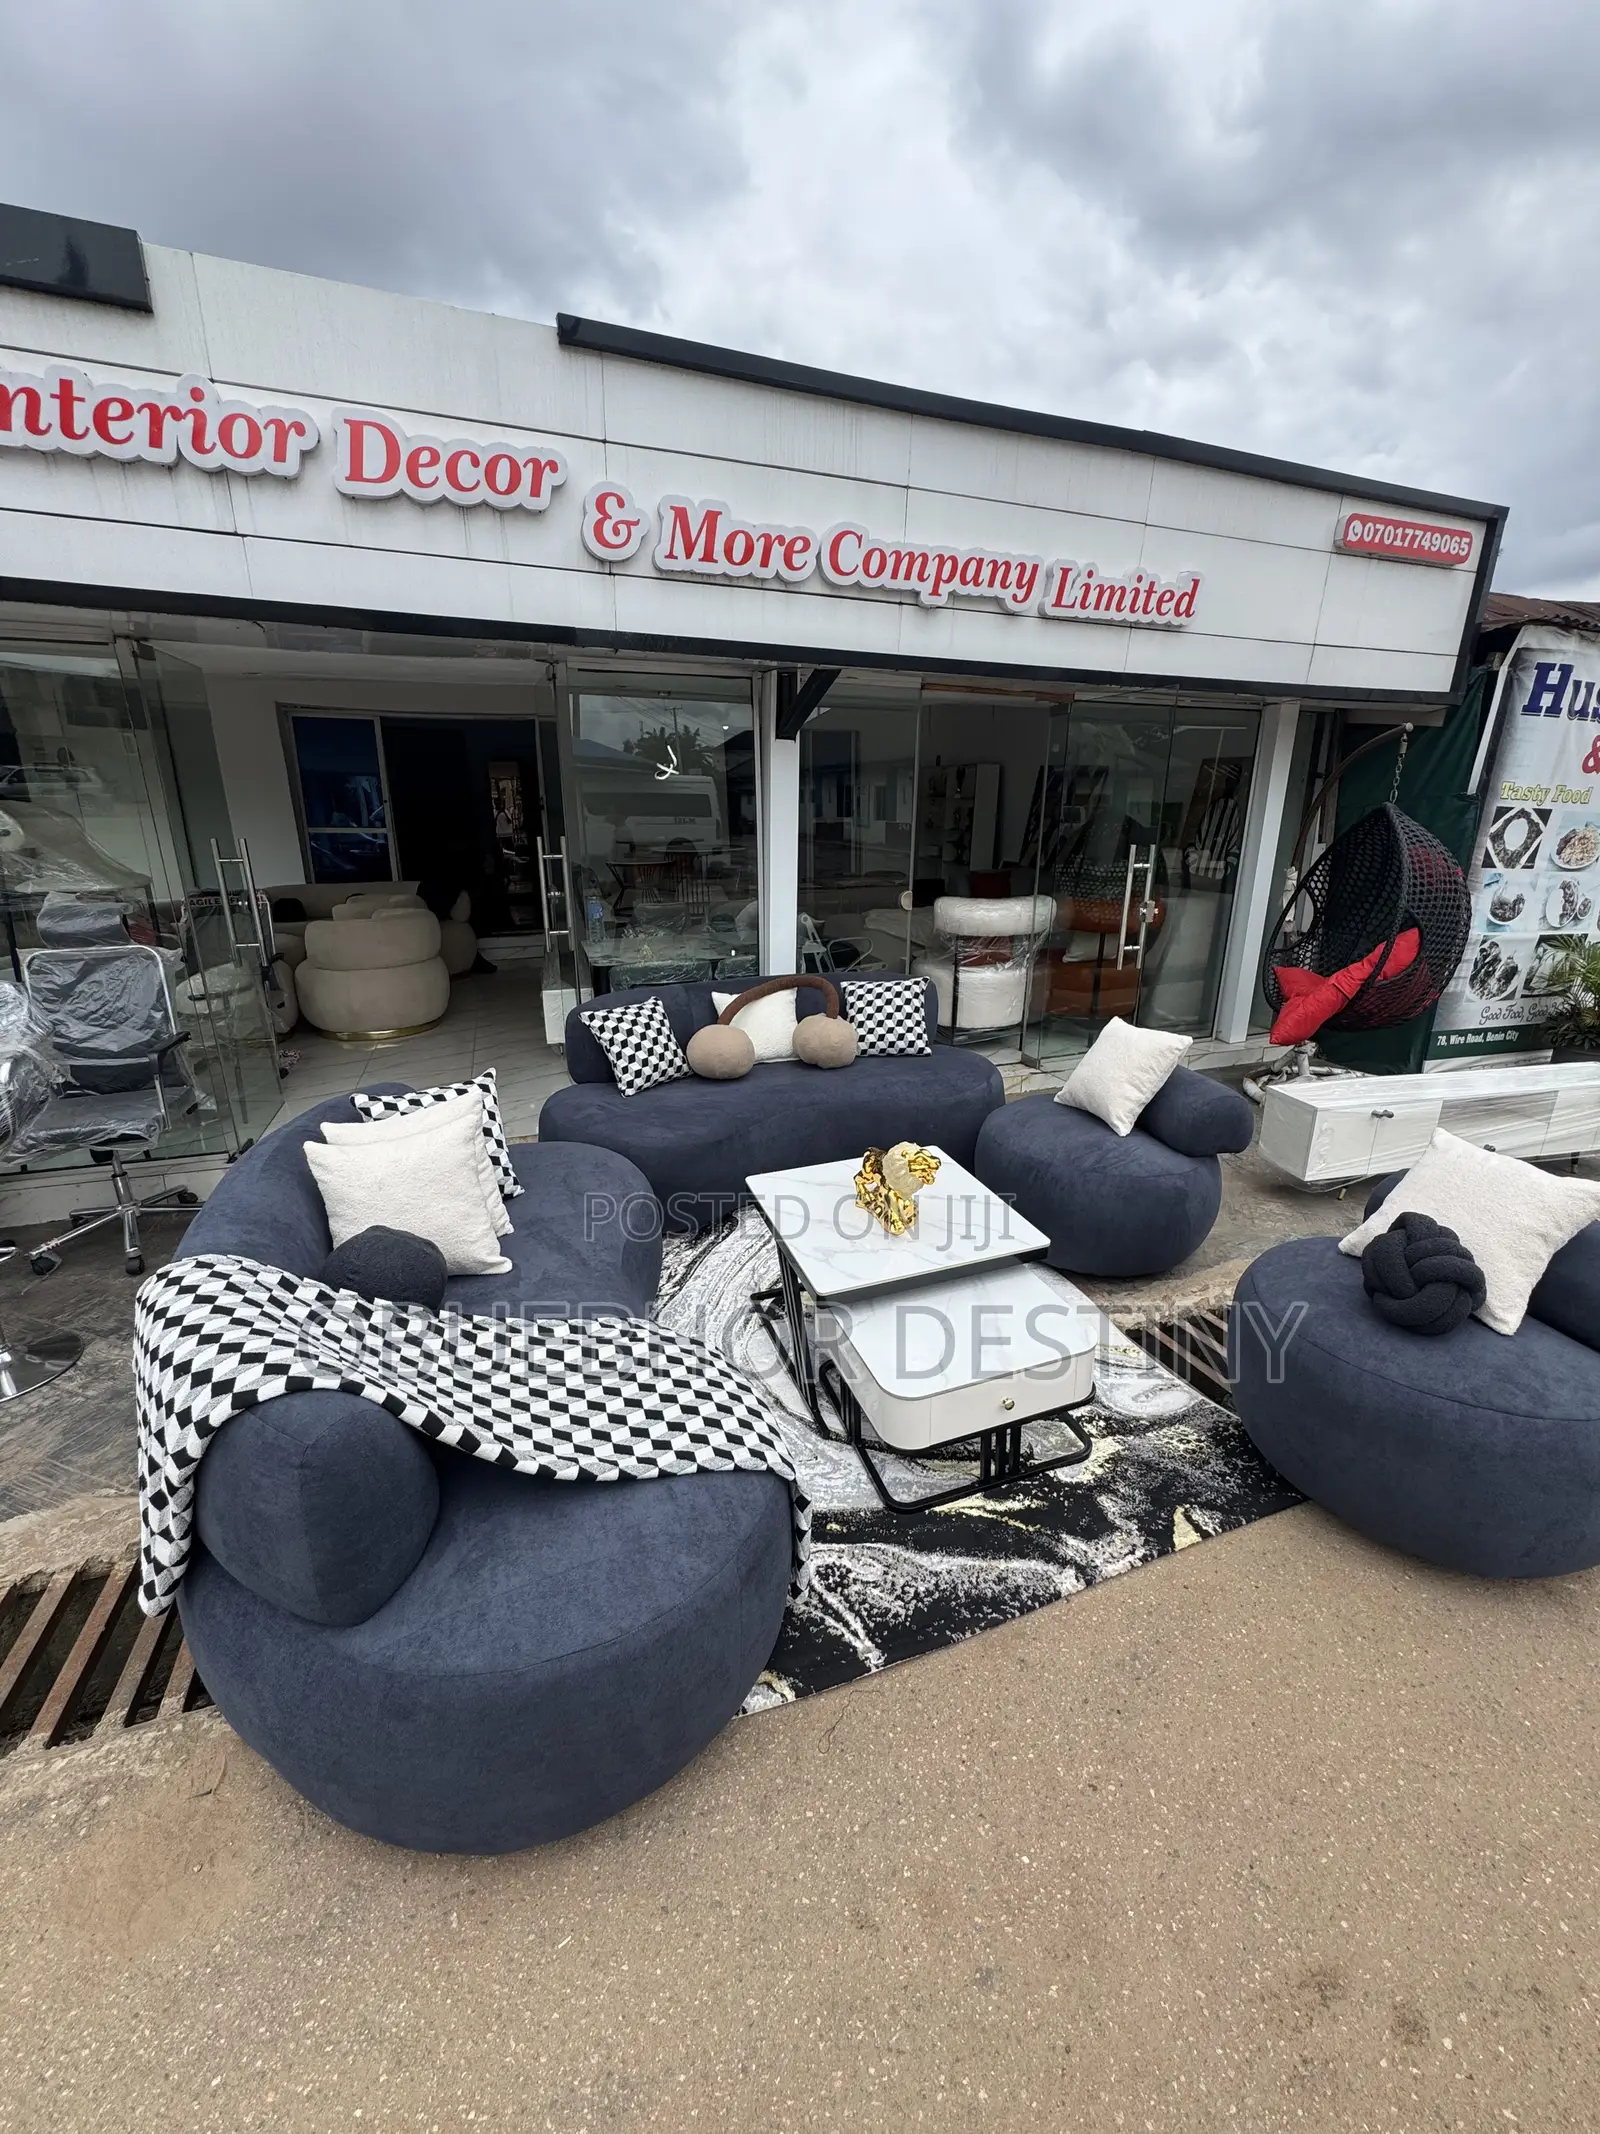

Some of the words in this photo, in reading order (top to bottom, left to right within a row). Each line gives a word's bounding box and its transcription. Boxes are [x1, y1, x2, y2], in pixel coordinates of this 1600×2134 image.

[345, 418, 558, 498] Decor
[593, 491, 640, 549] &
[665, 504, 812, 571] More
[829, 530, 1039, 604] Company
[1052, 567, 1200, 618] Limited
[1363, 522, 1470, 556] 07017749065
[1500, 781, 1550, 806] Tasty
[1551, 784, 1593, 805] Food
[1479, 1005, 1502, 1025] Good
[1436, 1035, 1447, 1046] 78,
[1449, 1034, 1465, 1045] Wire
[1466, 1032, 1485, 1043] Road,
[1486, 1031, 1505, 1042] Benin
[1506, 1030, 1519, 1041] City
